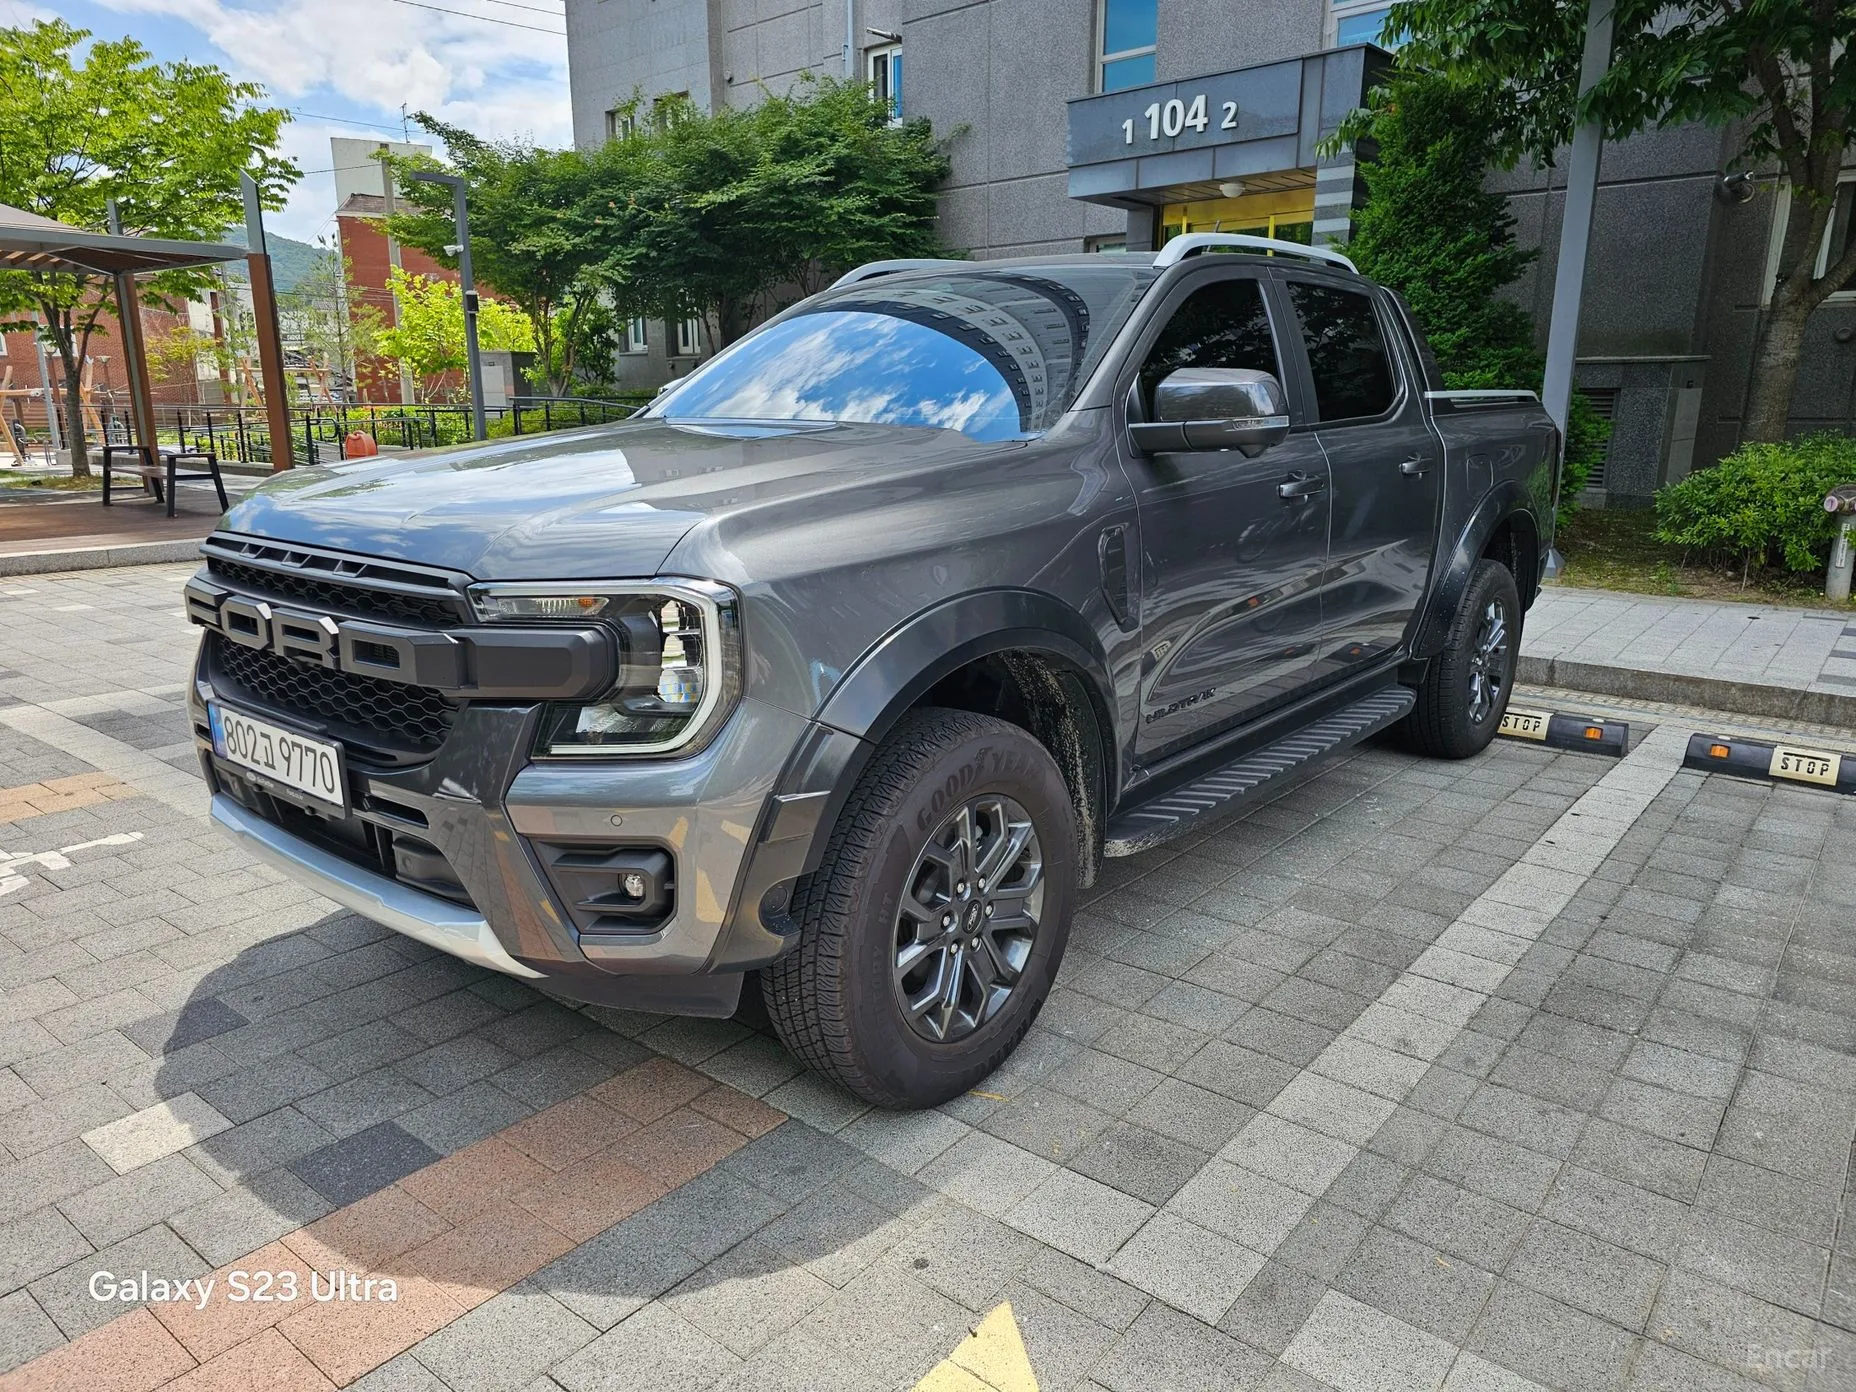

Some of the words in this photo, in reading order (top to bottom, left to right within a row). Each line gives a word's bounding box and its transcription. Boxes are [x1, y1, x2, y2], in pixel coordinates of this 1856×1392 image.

[1121, 118, 1134, 145] 1
[1144, 94, 1209, 140] 104
[1220, 101, 1238, 130] 2
[183, 579, 452, 690] FORD
[1502, 715, 1541, 732] STOP
[1780, 756, 1830, 776] STOP
